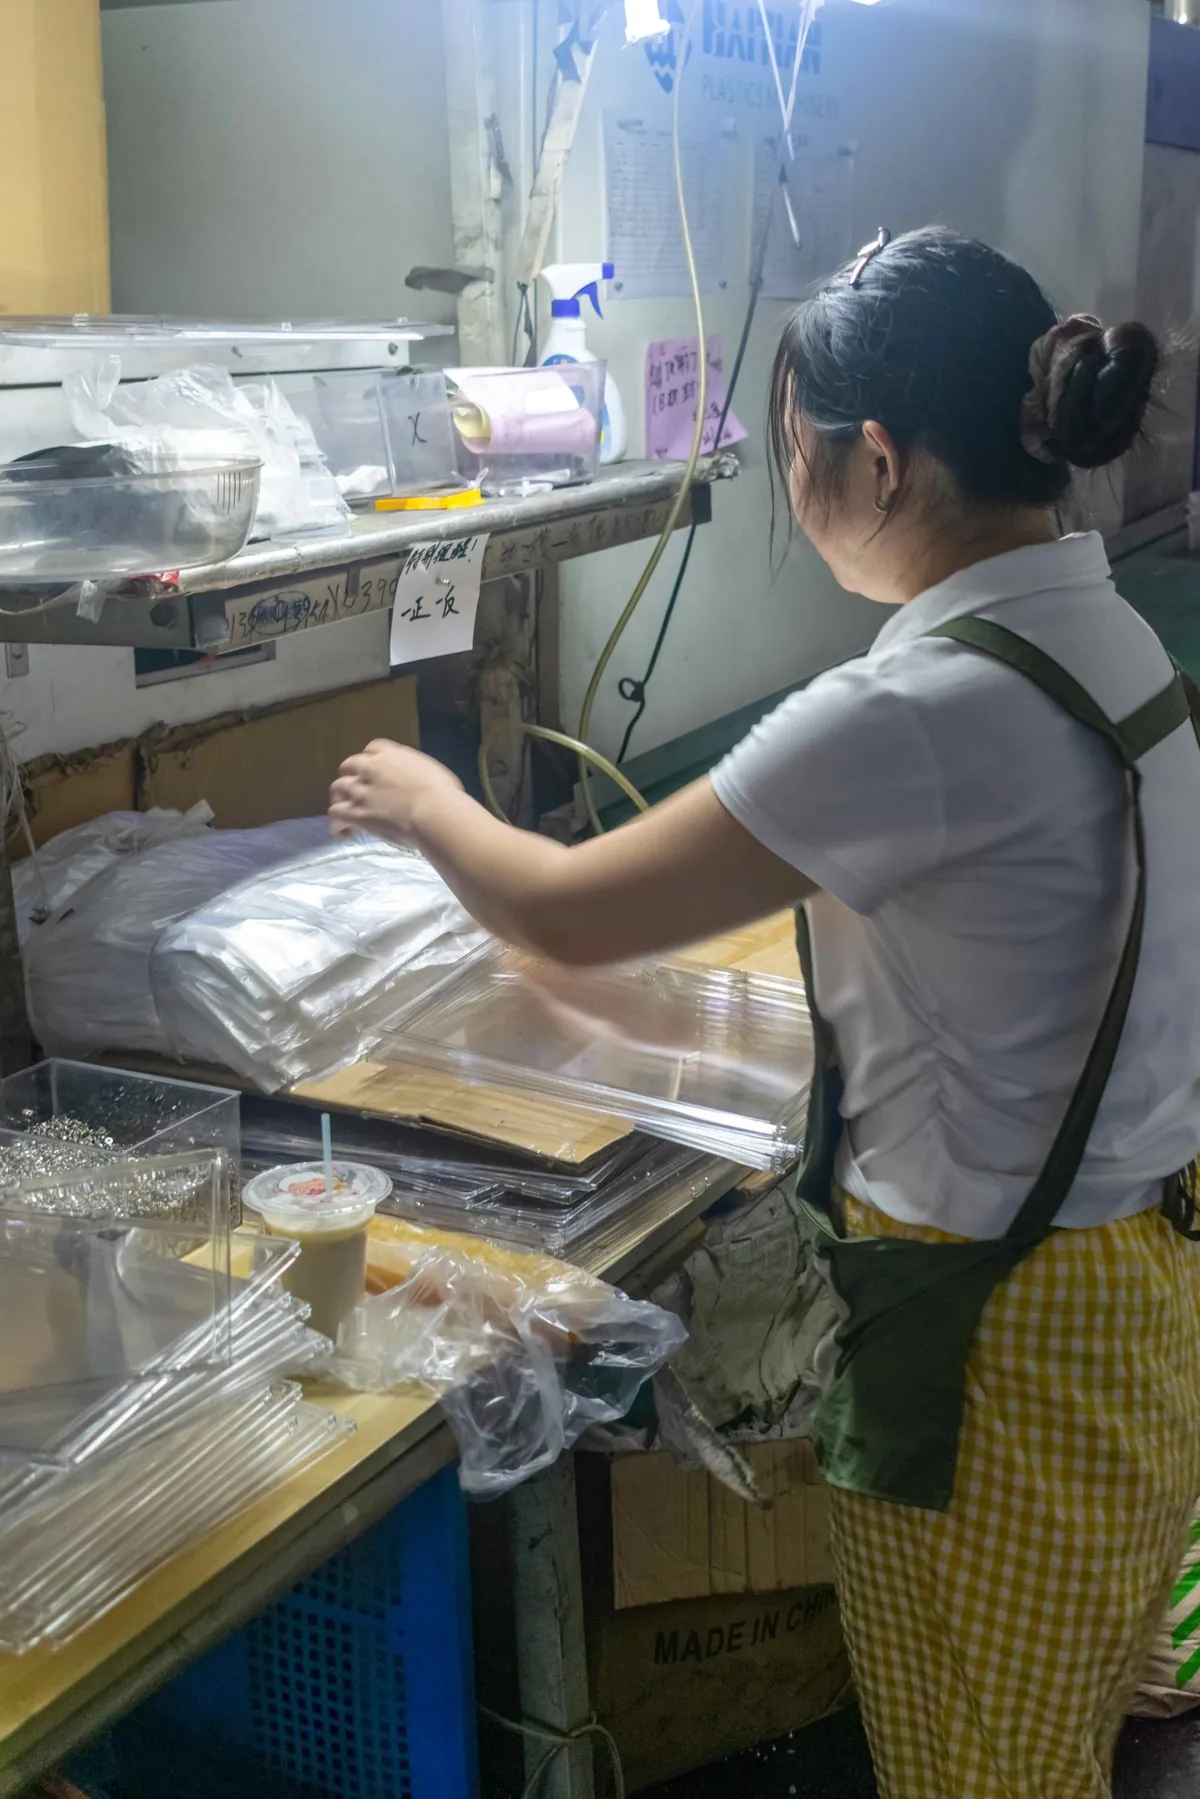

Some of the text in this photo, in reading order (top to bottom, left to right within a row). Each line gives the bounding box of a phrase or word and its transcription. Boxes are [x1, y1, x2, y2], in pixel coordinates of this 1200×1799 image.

[654, 1588, 836, 1665] MADE IN CHIN
